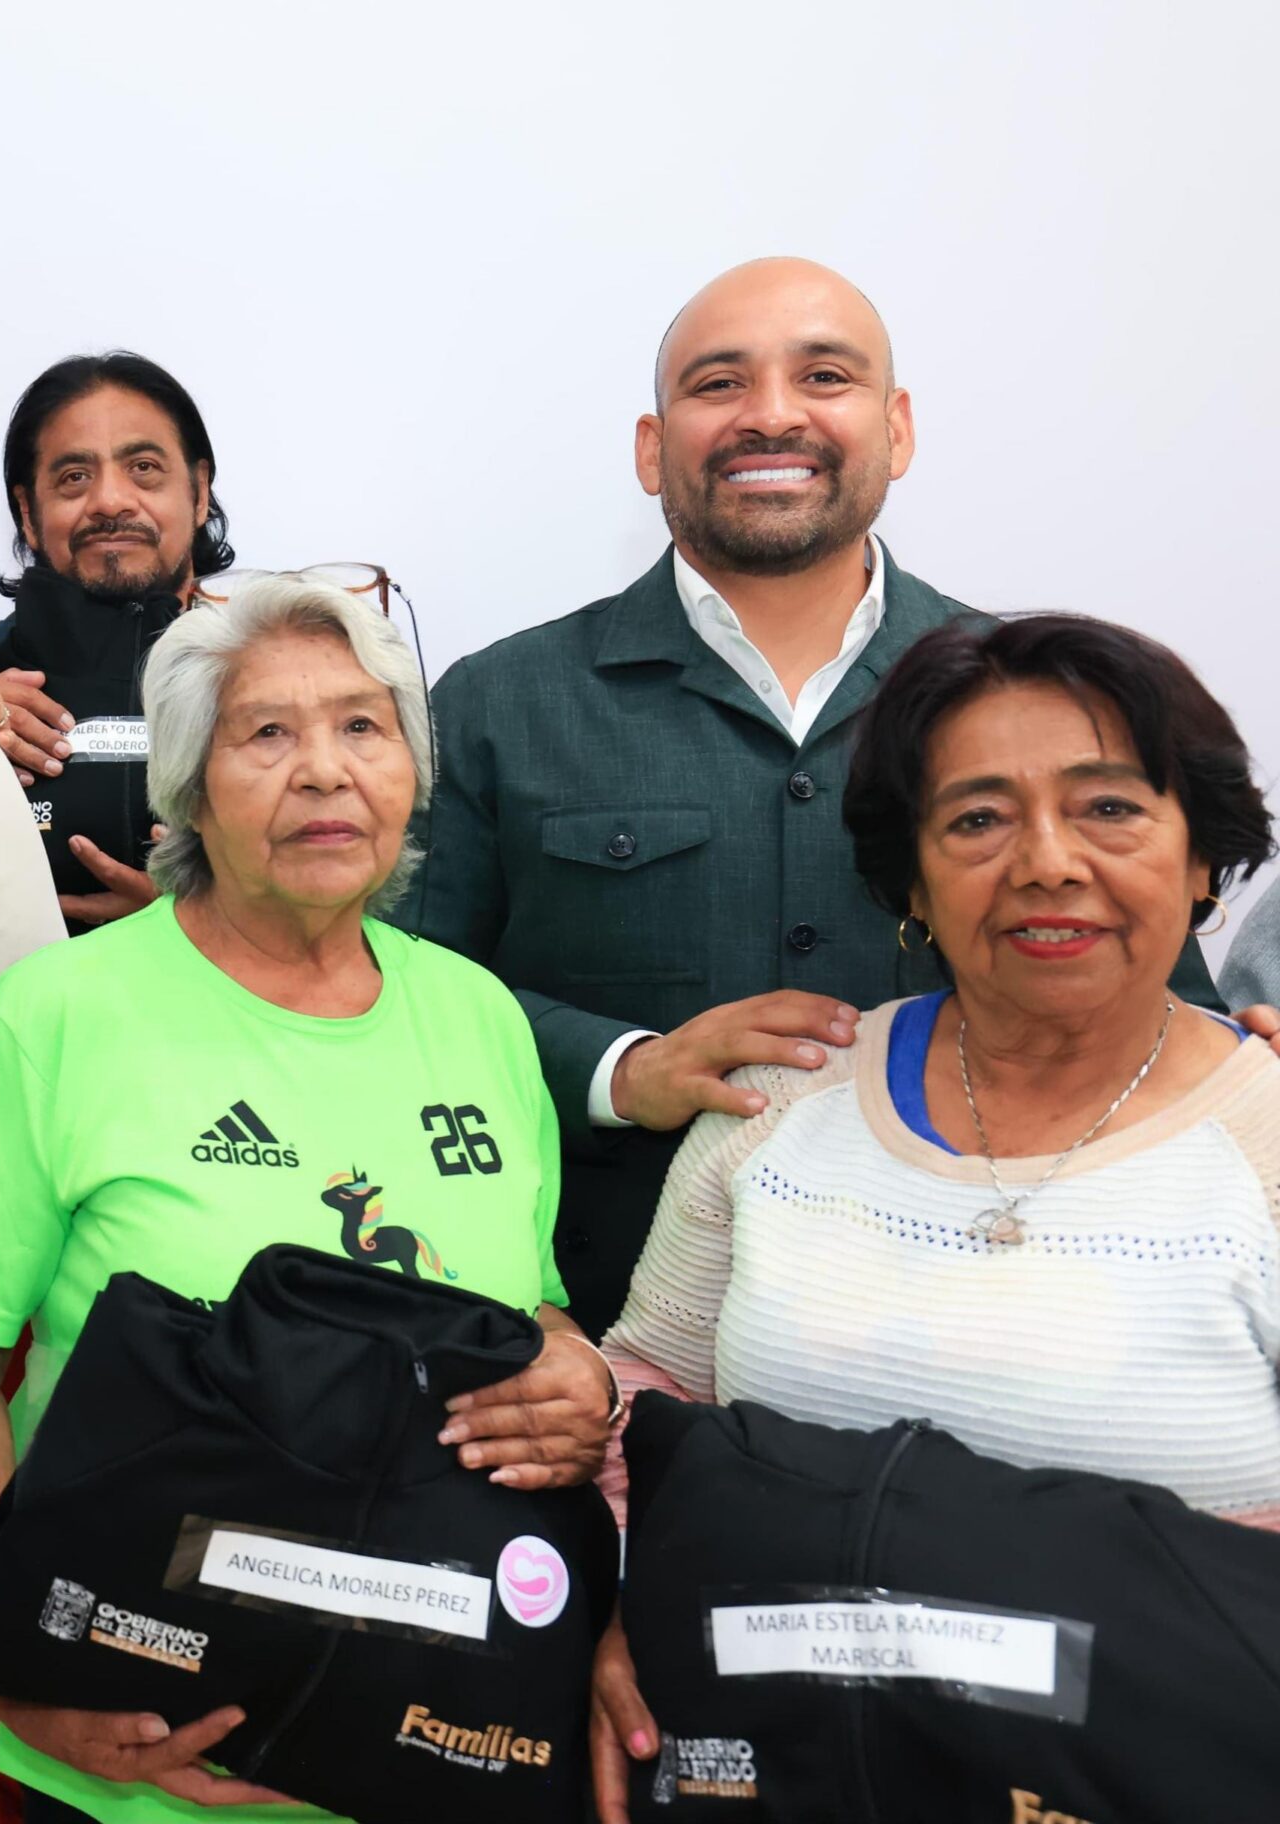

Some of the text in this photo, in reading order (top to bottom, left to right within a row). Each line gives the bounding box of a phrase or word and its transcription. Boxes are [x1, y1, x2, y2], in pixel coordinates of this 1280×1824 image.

[190, 1139, 300, 1168] adidas
[419, 1103, 503, 1177] 26
[226, 1553, 471, 1616] ANGELICA MORALES PEREZ
[116, 1624, 204, 1661] ESTADO
[746, 1611, 1005, 1644] MARIA ESTELA RAMIREZ
[811, 1646, 918, 1669] MARISCAL
[401, 1703, 552, 1767] Familias
